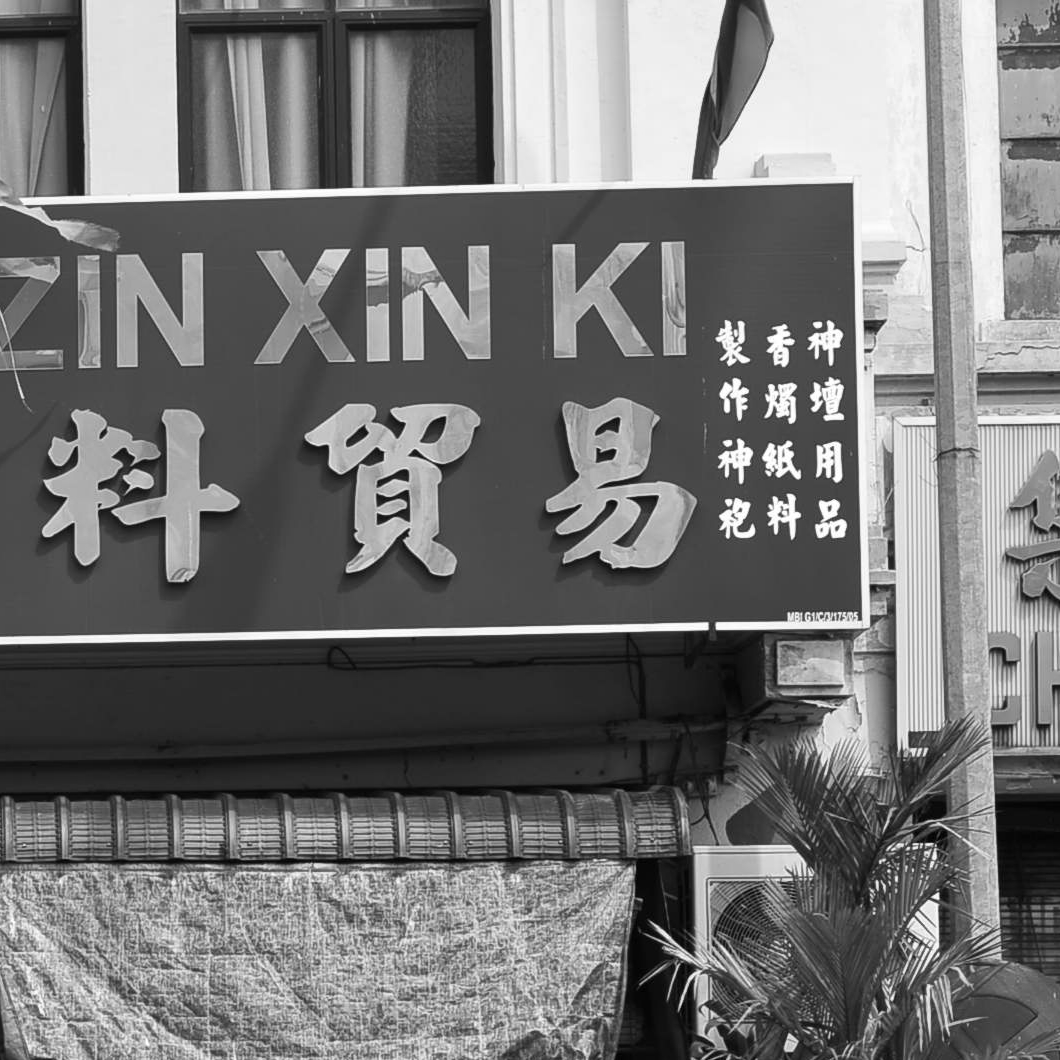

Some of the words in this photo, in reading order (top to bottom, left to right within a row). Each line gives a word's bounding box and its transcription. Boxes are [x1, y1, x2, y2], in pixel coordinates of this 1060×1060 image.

[254, 244, 492, 364] XIN
[551, 240, 687, 360] KI
[761, 323, 802, 541] 香燭紙料
[807, 319, 848, 540] 神壇用品
